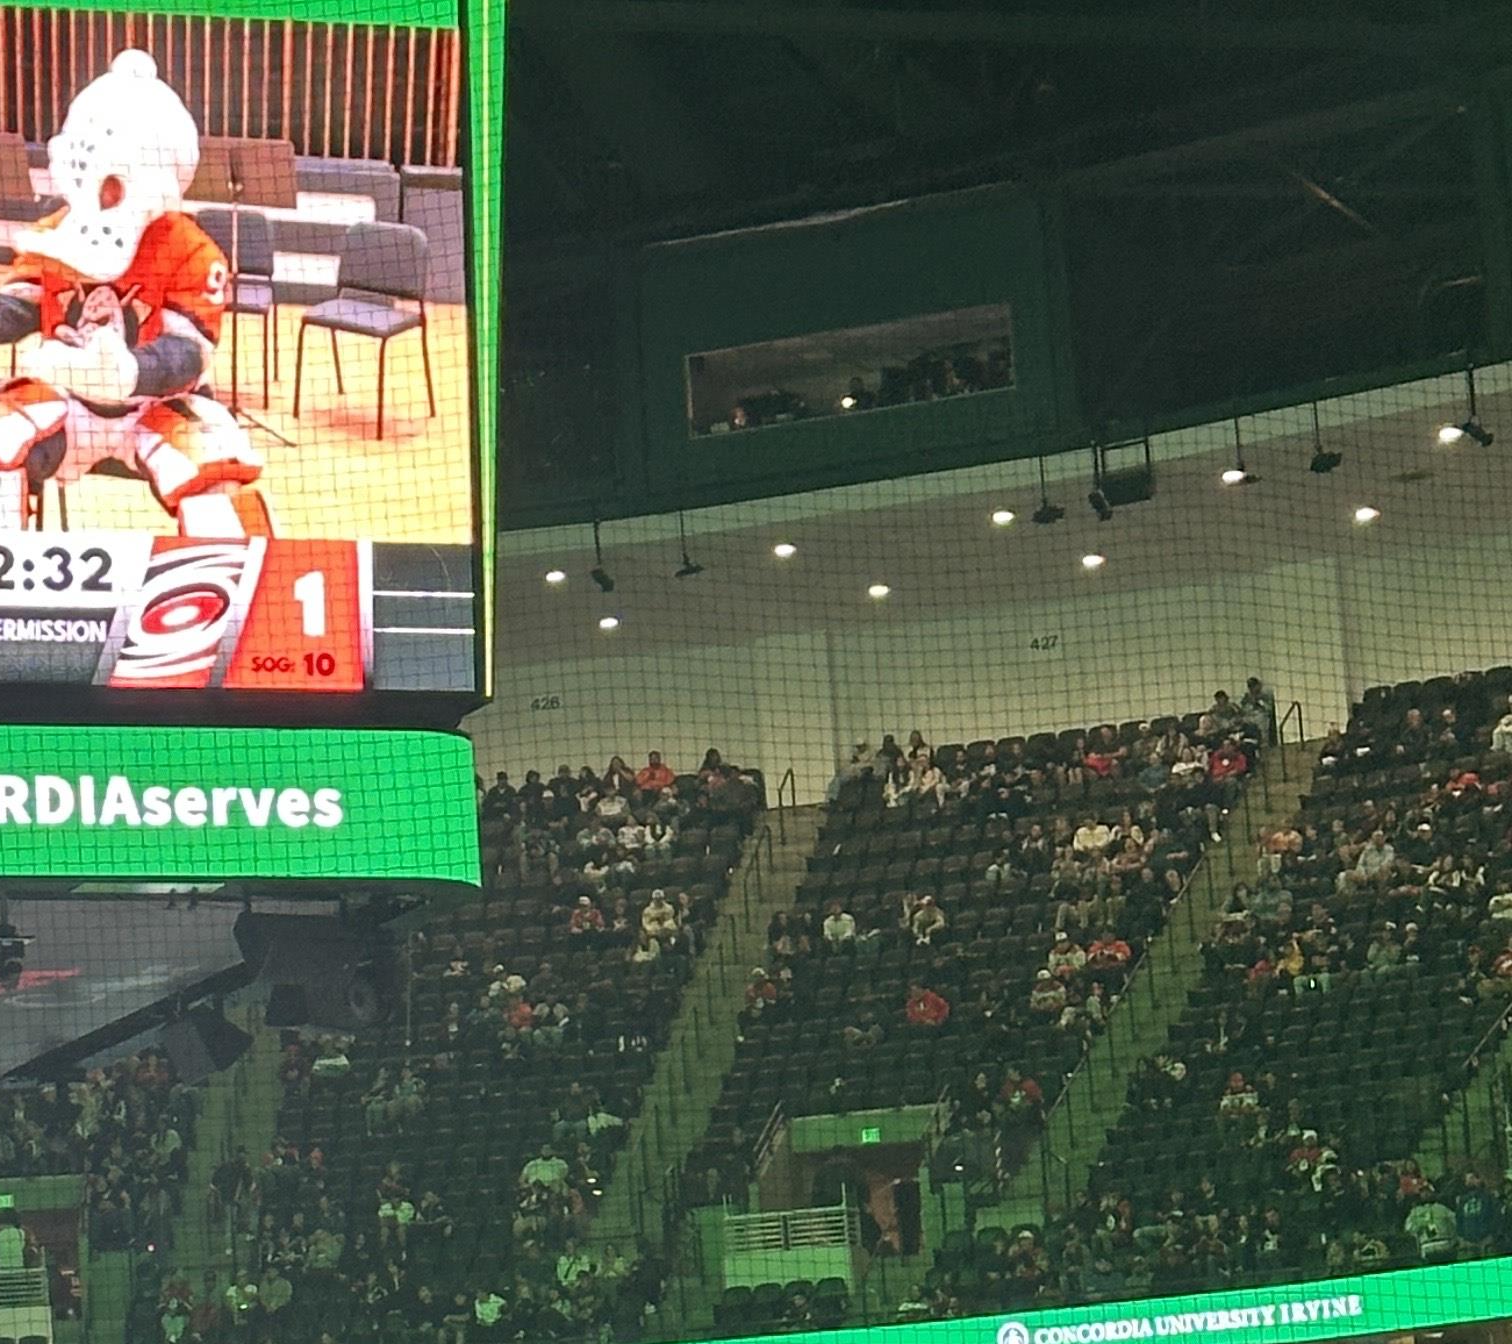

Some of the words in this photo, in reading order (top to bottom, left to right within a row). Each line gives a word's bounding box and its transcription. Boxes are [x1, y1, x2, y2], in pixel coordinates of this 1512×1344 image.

[292, 571, 327, 638] 1
[1031, 635, 1059, 652] 427
[304, 652, 336, 677] 10
[1154, 1304, 1276, 1336] UNIVERSITY
[1280, 1293, 1363, 1325] IRVINE
